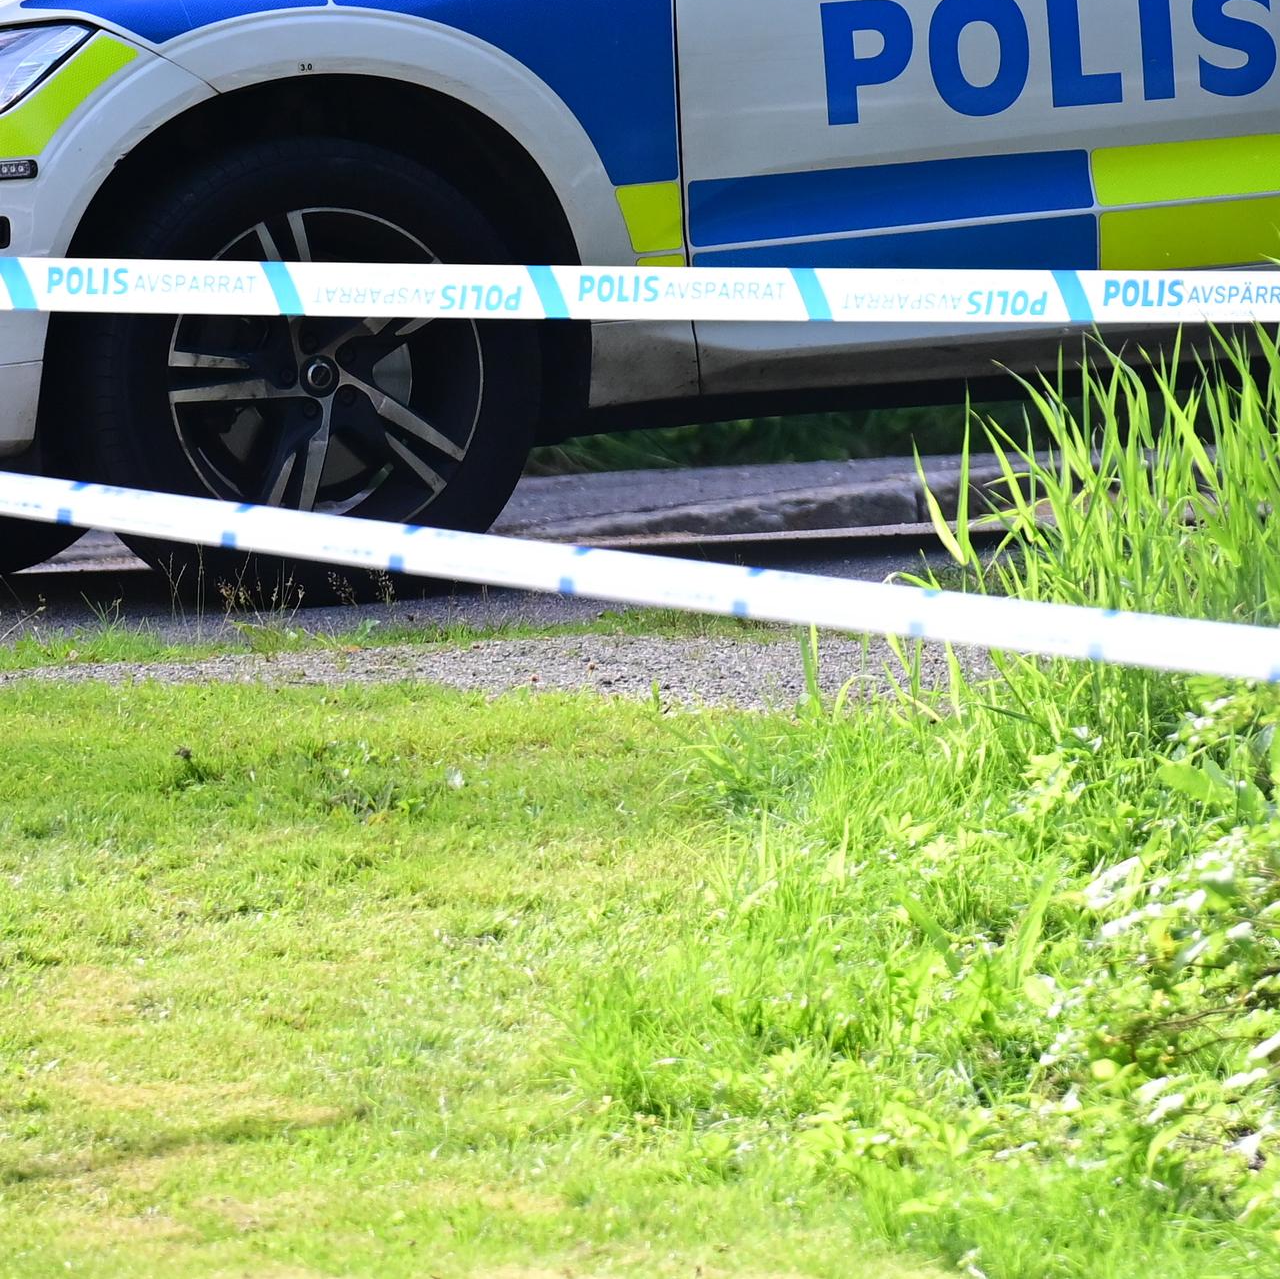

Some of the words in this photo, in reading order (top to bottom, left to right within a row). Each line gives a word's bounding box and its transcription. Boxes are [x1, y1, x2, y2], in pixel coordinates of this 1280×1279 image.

[47, 266, 129, 295] POLIS
[578, 275, 660, 302] POLIS
[1103, 279, 1184, 307] POLIS
[440, 285, 523, 311] POLIS
[966, 290, 1048, 316] POLIS
